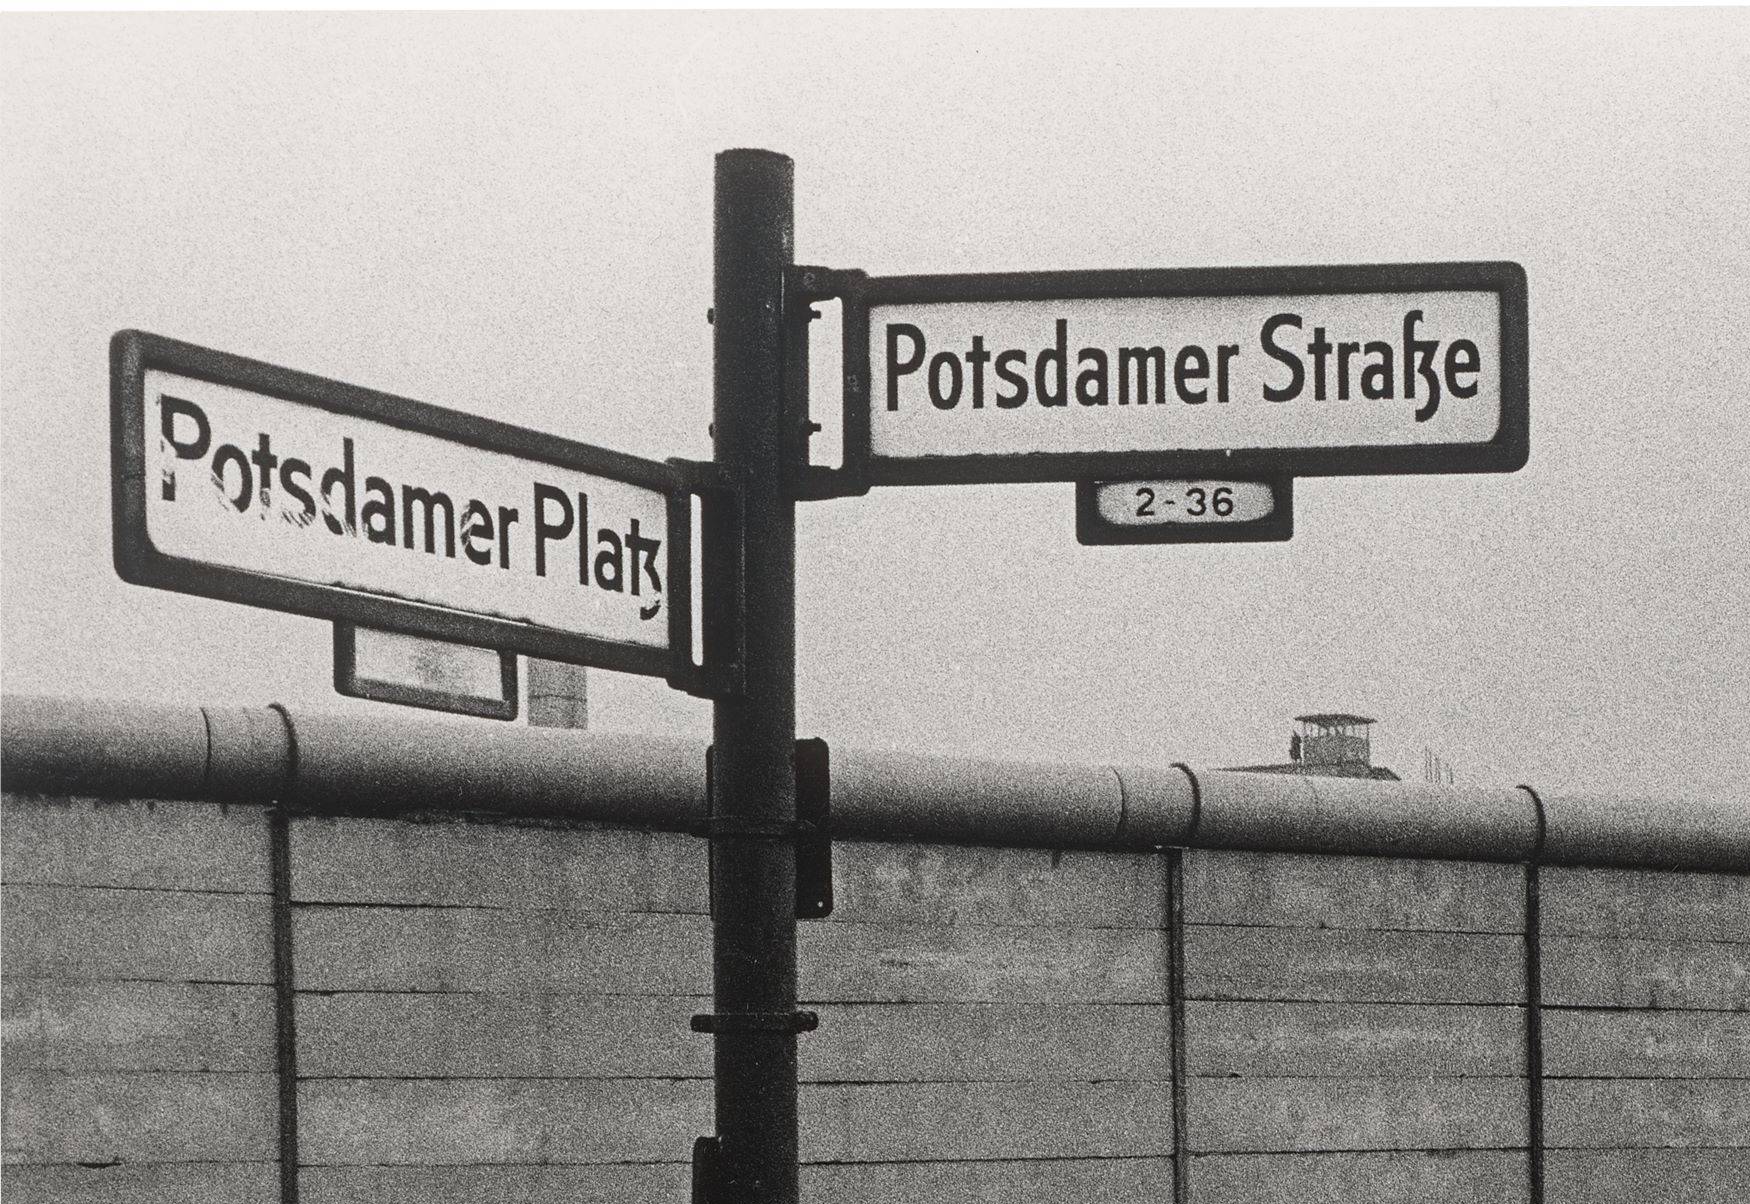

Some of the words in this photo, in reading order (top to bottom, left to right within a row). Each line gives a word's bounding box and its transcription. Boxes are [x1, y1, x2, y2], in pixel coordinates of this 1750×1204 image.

[886, 319, 1240, 412] Potsdamer
[1260, 309, 1481, 423] Straße
[159, 393, 519, 570] Potsdamer
[533, 482, 663, 621] Platz
